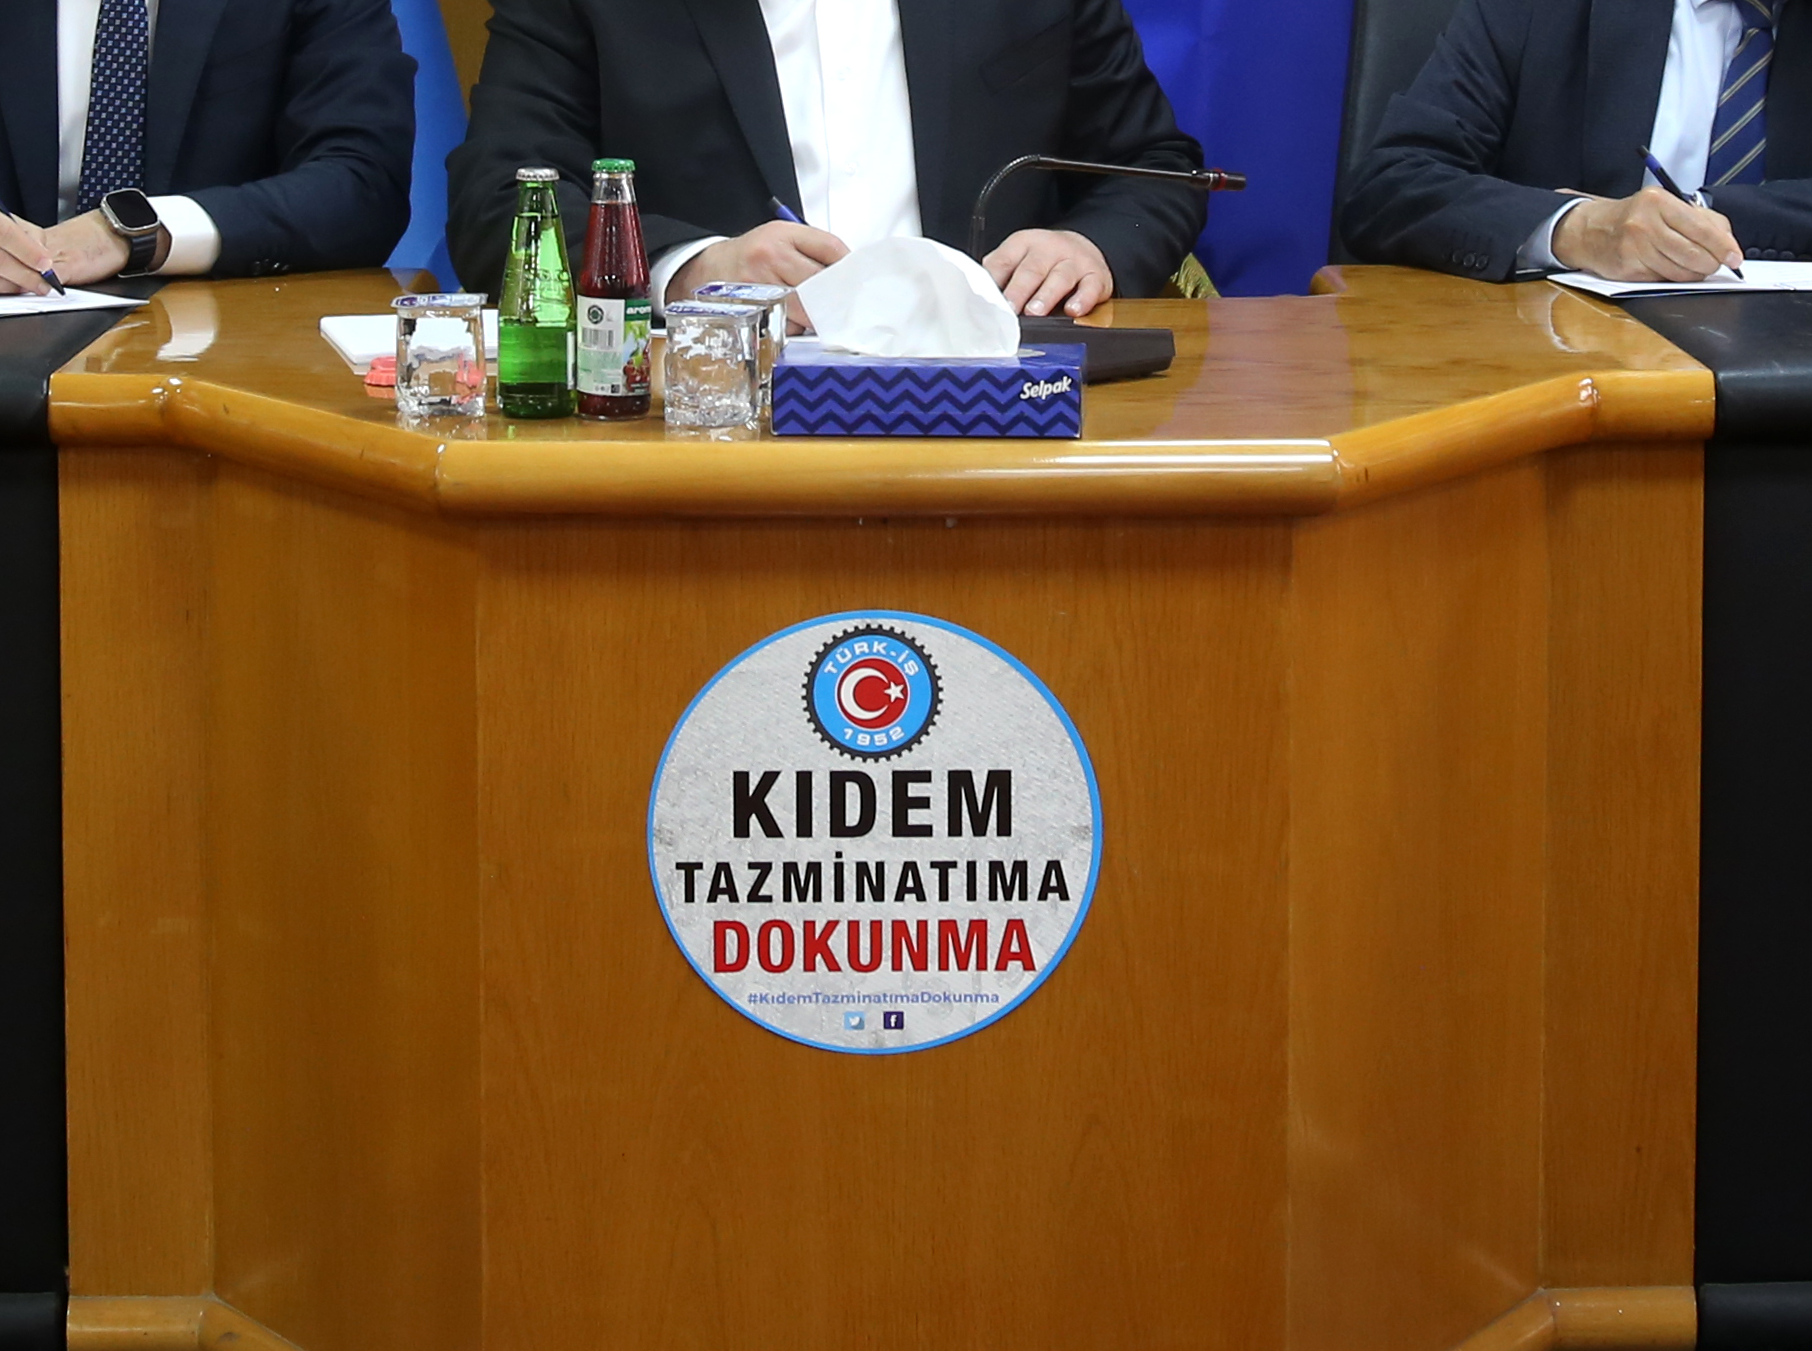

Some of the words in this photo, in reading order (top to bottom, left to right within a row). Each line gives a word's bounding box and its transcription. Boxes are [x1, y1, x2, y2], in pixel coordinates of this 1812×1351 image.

[1020, 375, 1072, 401] Selpak
[824, 640, 920, 677] TÜRK-İŞ
[843, 725, 905, 746] 1952
[732, 769, 1013, 839] KIDEM
[675, 851, 1071, 903] TAZMİNATIMA
[712, 919, 1037, 973] DOKUNMA
